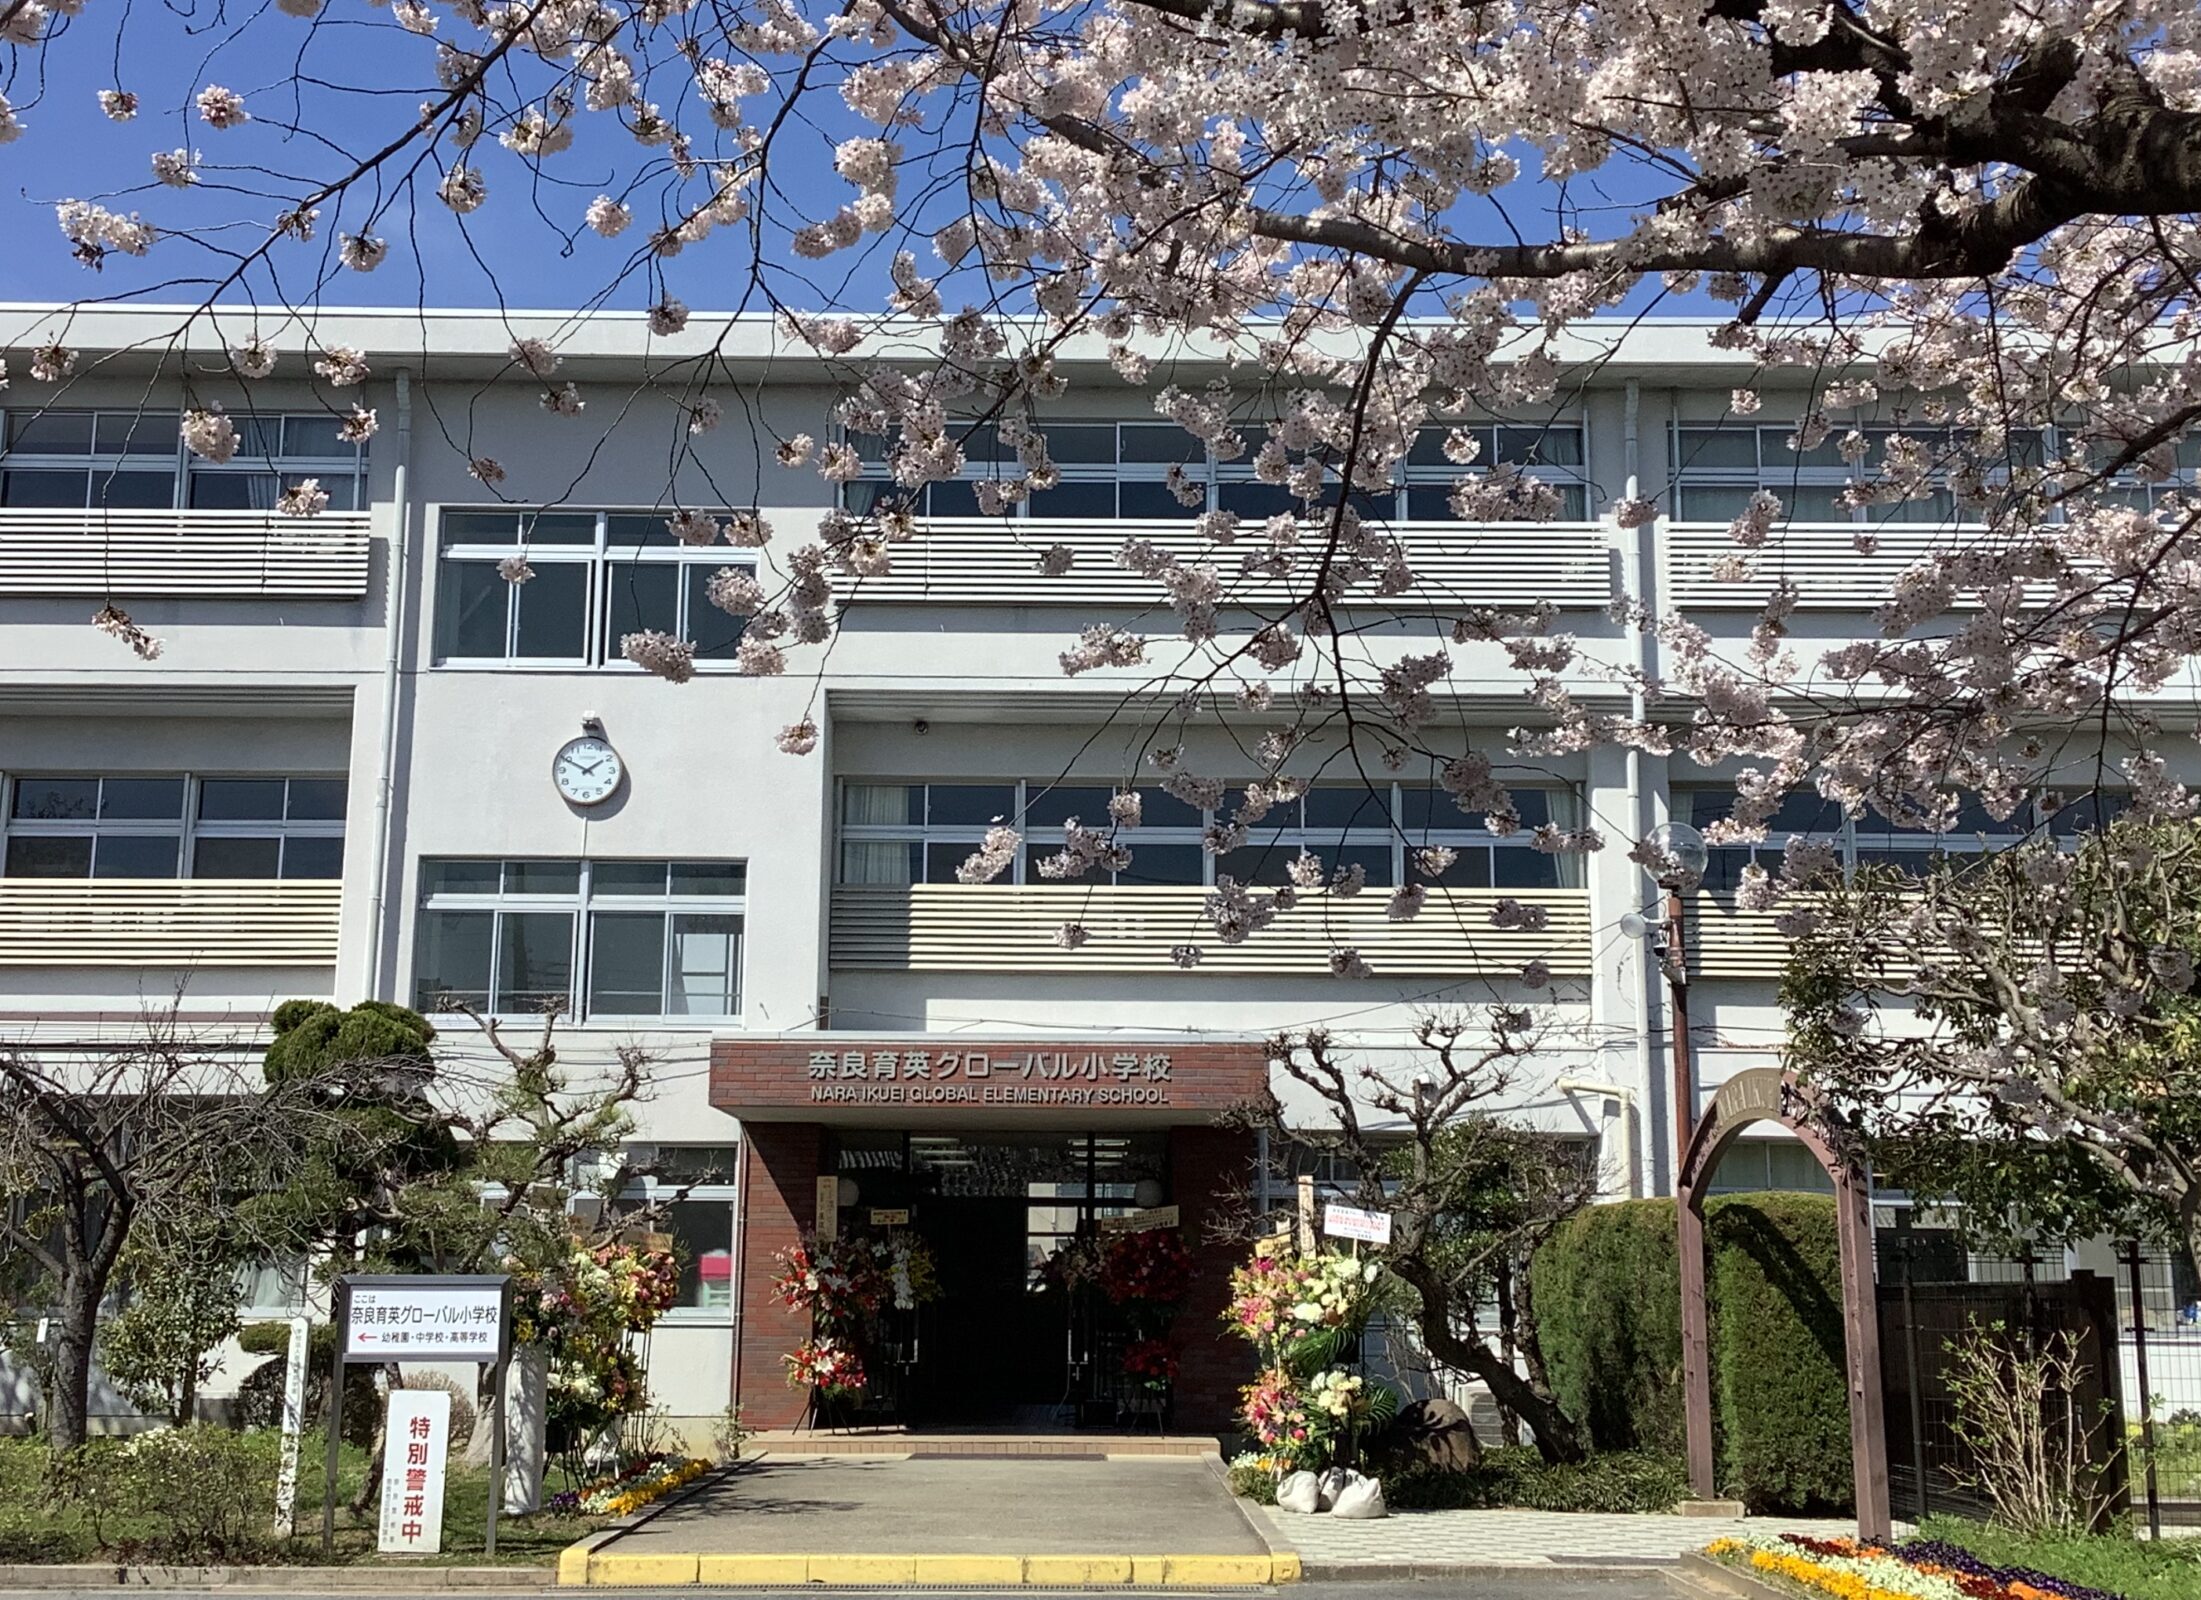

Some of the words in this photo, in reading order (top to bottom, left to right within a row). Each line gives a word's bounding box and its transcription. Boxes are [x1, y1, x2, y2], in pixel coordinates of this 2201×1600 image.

[605, 754, 613, 762] 2
[559, 766, 567, 774] 9
[608, 766, 616, 775] 3
[561, 778, 569, 786] 8
[582, 791, 590, 799] 6
[808, 1050, 1172, 1080] 奈良育英グローバル小学校
[811, 1086, 857, 1101] NARA
[861, 1086, 906, 1101] IKUEI
[909, 1086, 978, 1102] GLOBAL
[983, 1087, 1094, 1102] ELEMENTARY
[1099, 1087, 1169, 1103] SCHOOL
[354, 1295, 377, 1304] ここは
[351, 1305, 498, 1325] 奈良育英グローバル小学校
[401, 1415, 432, 1545] 特別警戒中
